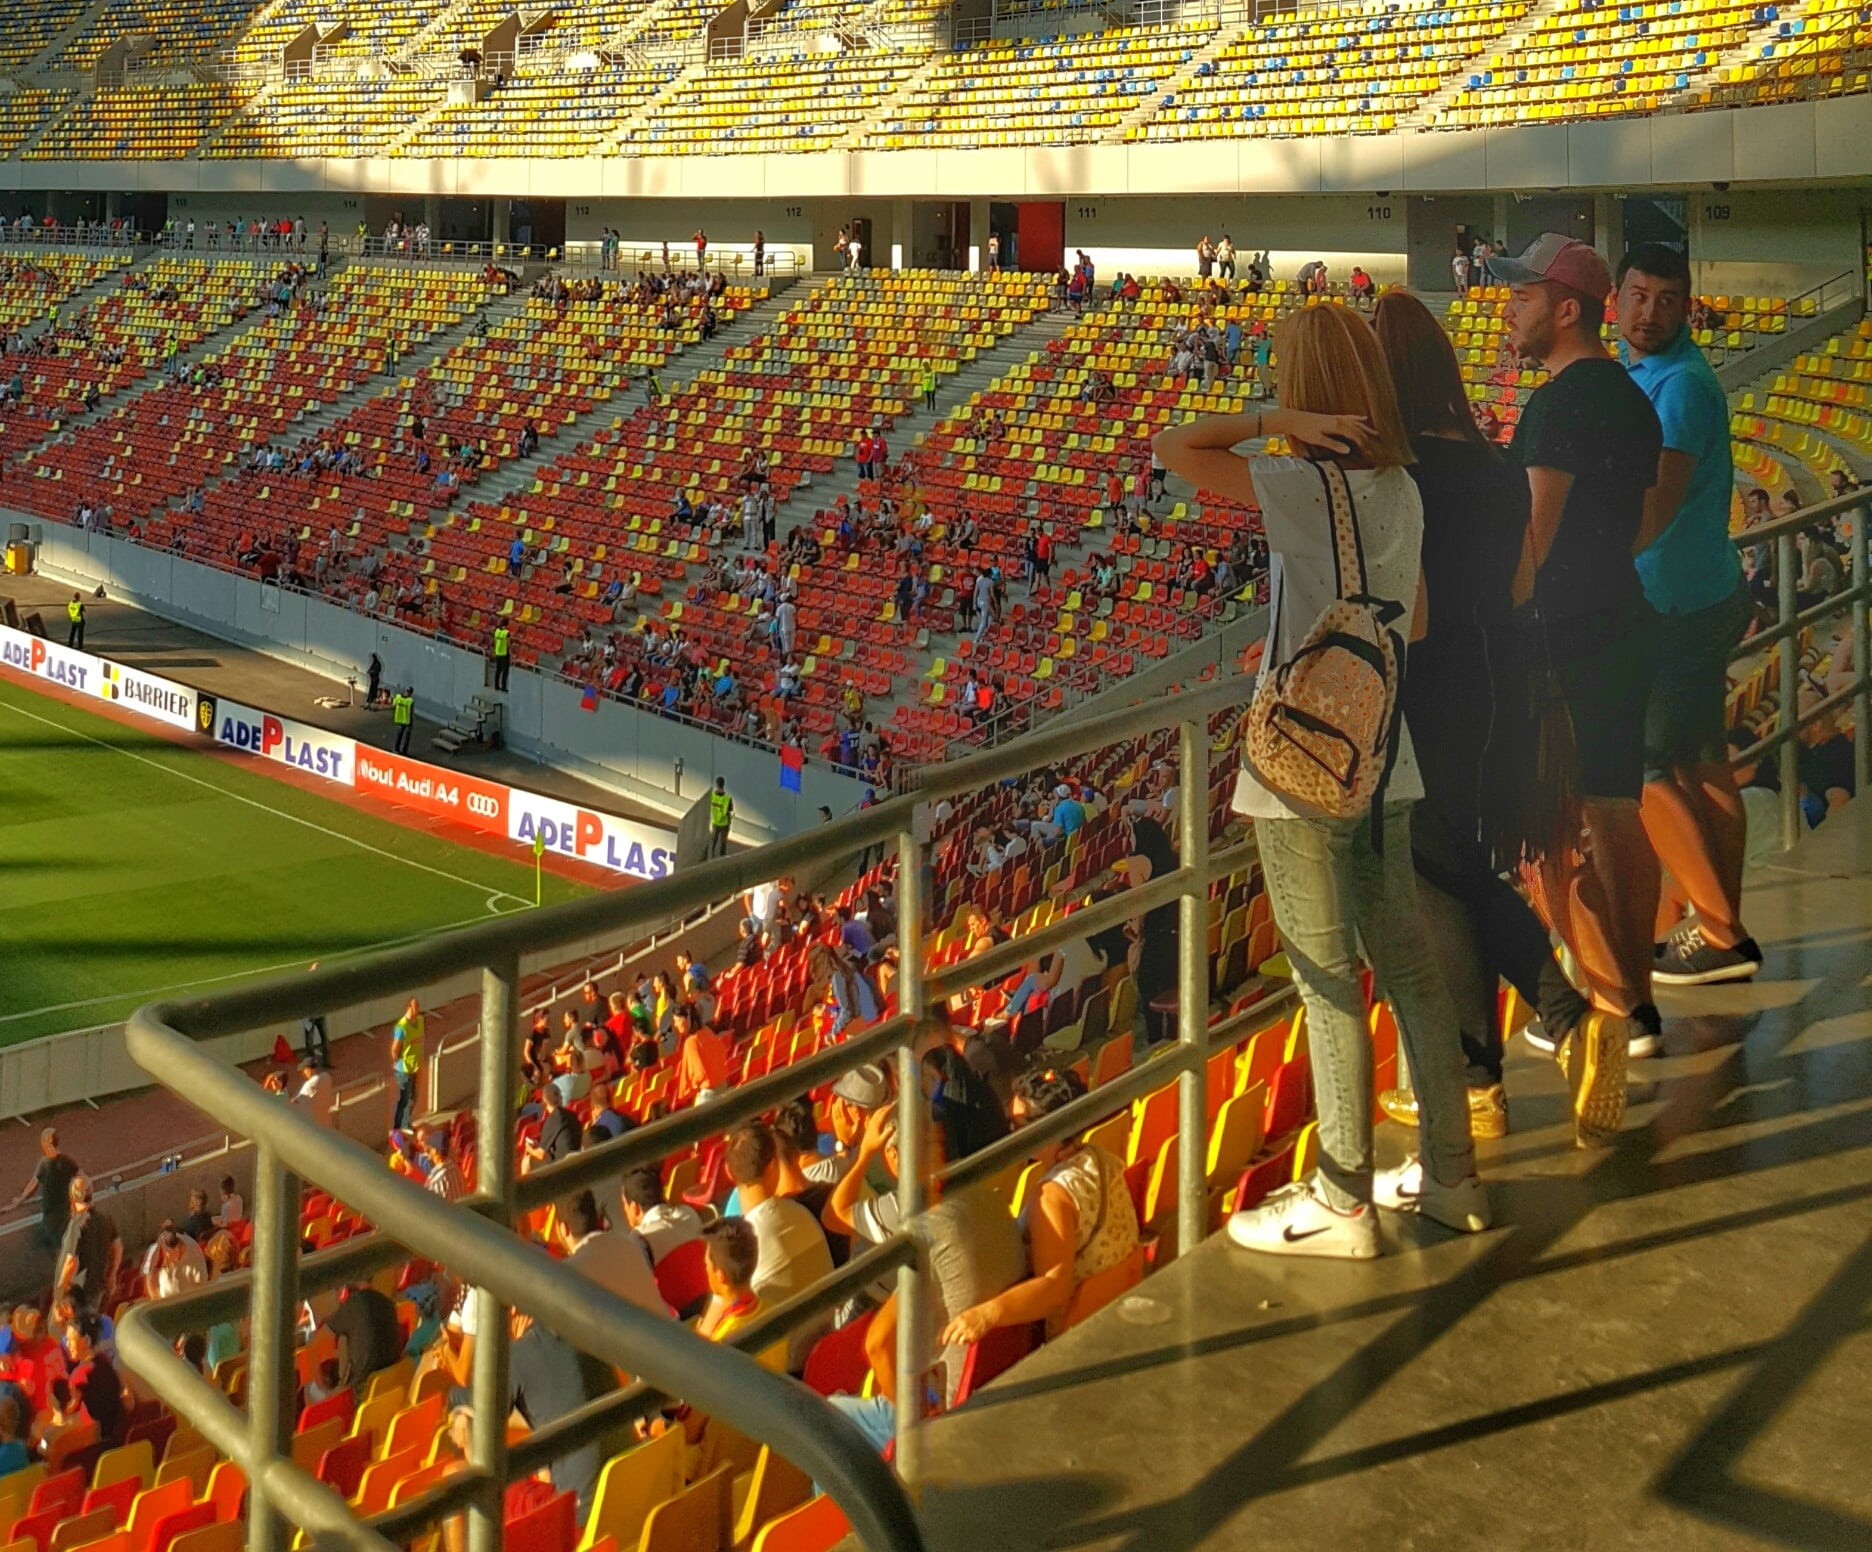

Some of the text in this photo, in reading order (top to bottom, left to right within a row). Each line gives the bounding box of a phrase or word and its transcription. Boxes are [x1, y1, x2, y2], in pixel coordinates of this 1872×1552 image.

[576, 206, 589, 215] 113
[786, 207, 802, 216] 112
[1078, 207, 1096, 219] 111
[1367, 207, 1391, 219] 110
[2, 638, 88, 690] ADEPLAST
[124, 677, 189, 719] BARRIER
[220, 714, 343, 778] ADEPLAST
[397, 771, 434, 798] Audi
[435, 783, 460, 806] A4
